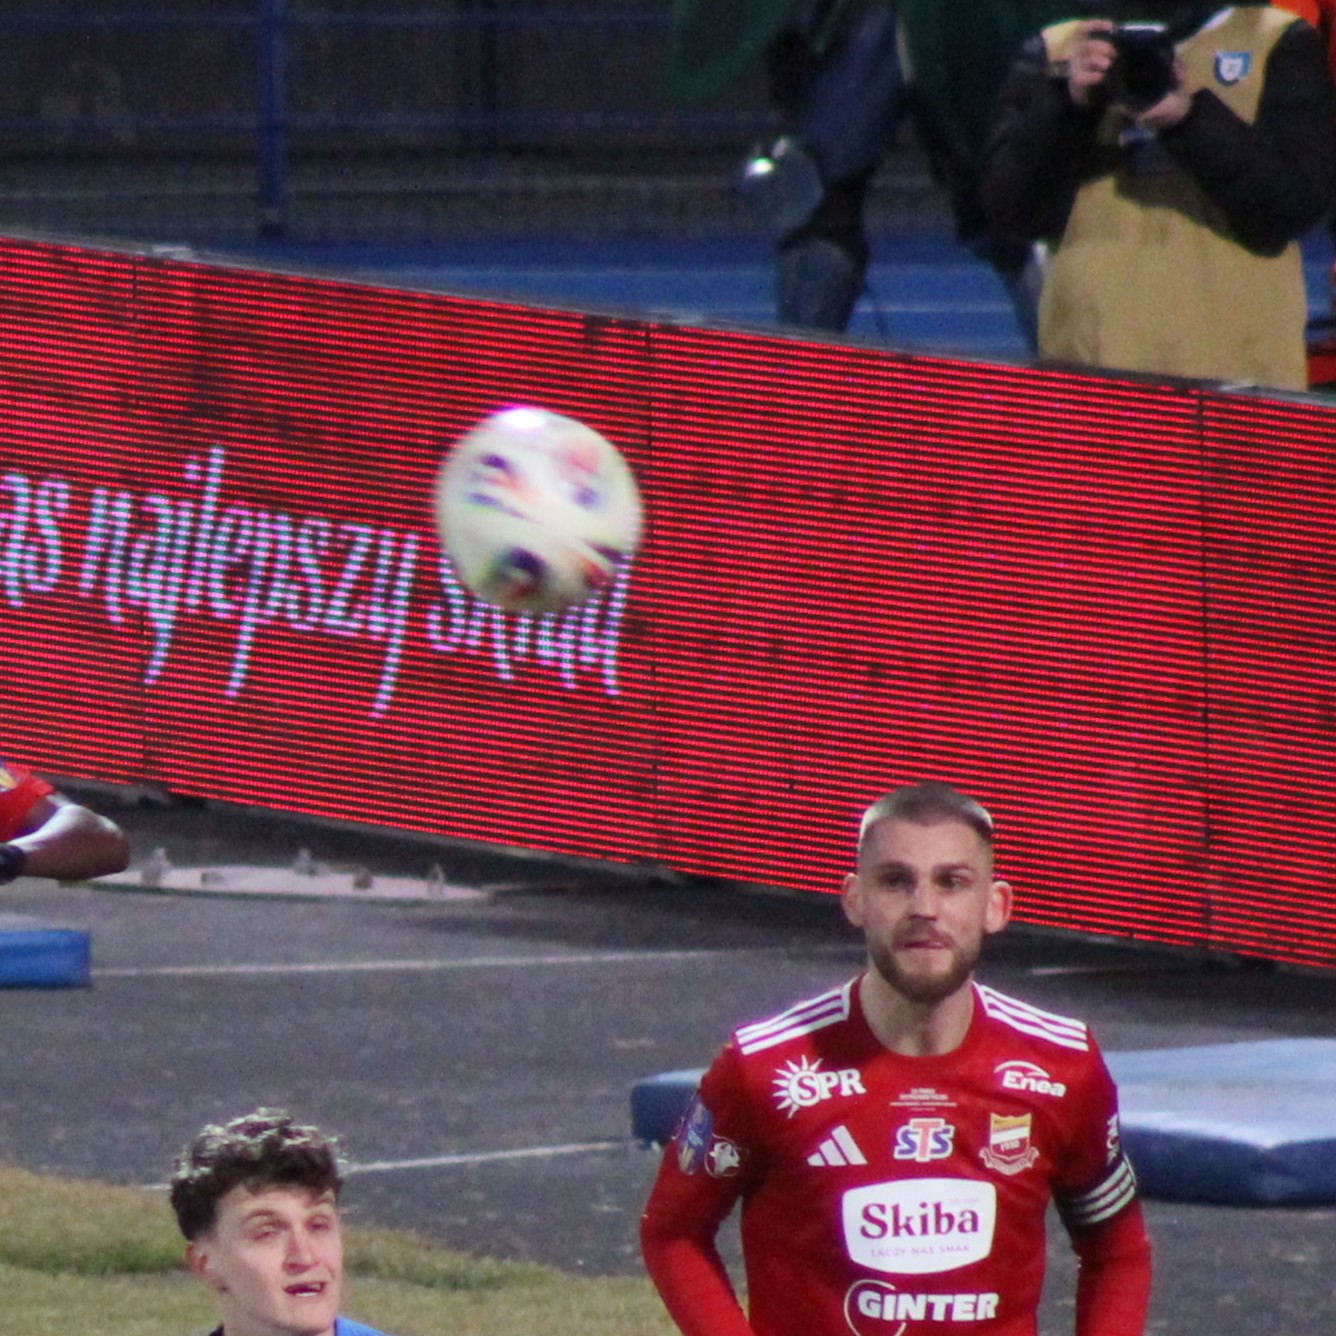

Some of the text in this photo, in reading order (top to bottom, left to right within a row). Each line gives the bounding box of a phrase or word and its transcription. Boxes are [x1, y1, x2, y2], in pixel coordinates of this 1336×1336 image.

[79, 446, 418, 718] najlepszy
[797, 1069, 866, 1102] SPR
[1002, 1070, 1066, 1099] Enea
[894, 1118, 955, 1162] STS
[860, 1201, 979, 1239] Skiba
[857, 1290, 999, 1321] GINTER
